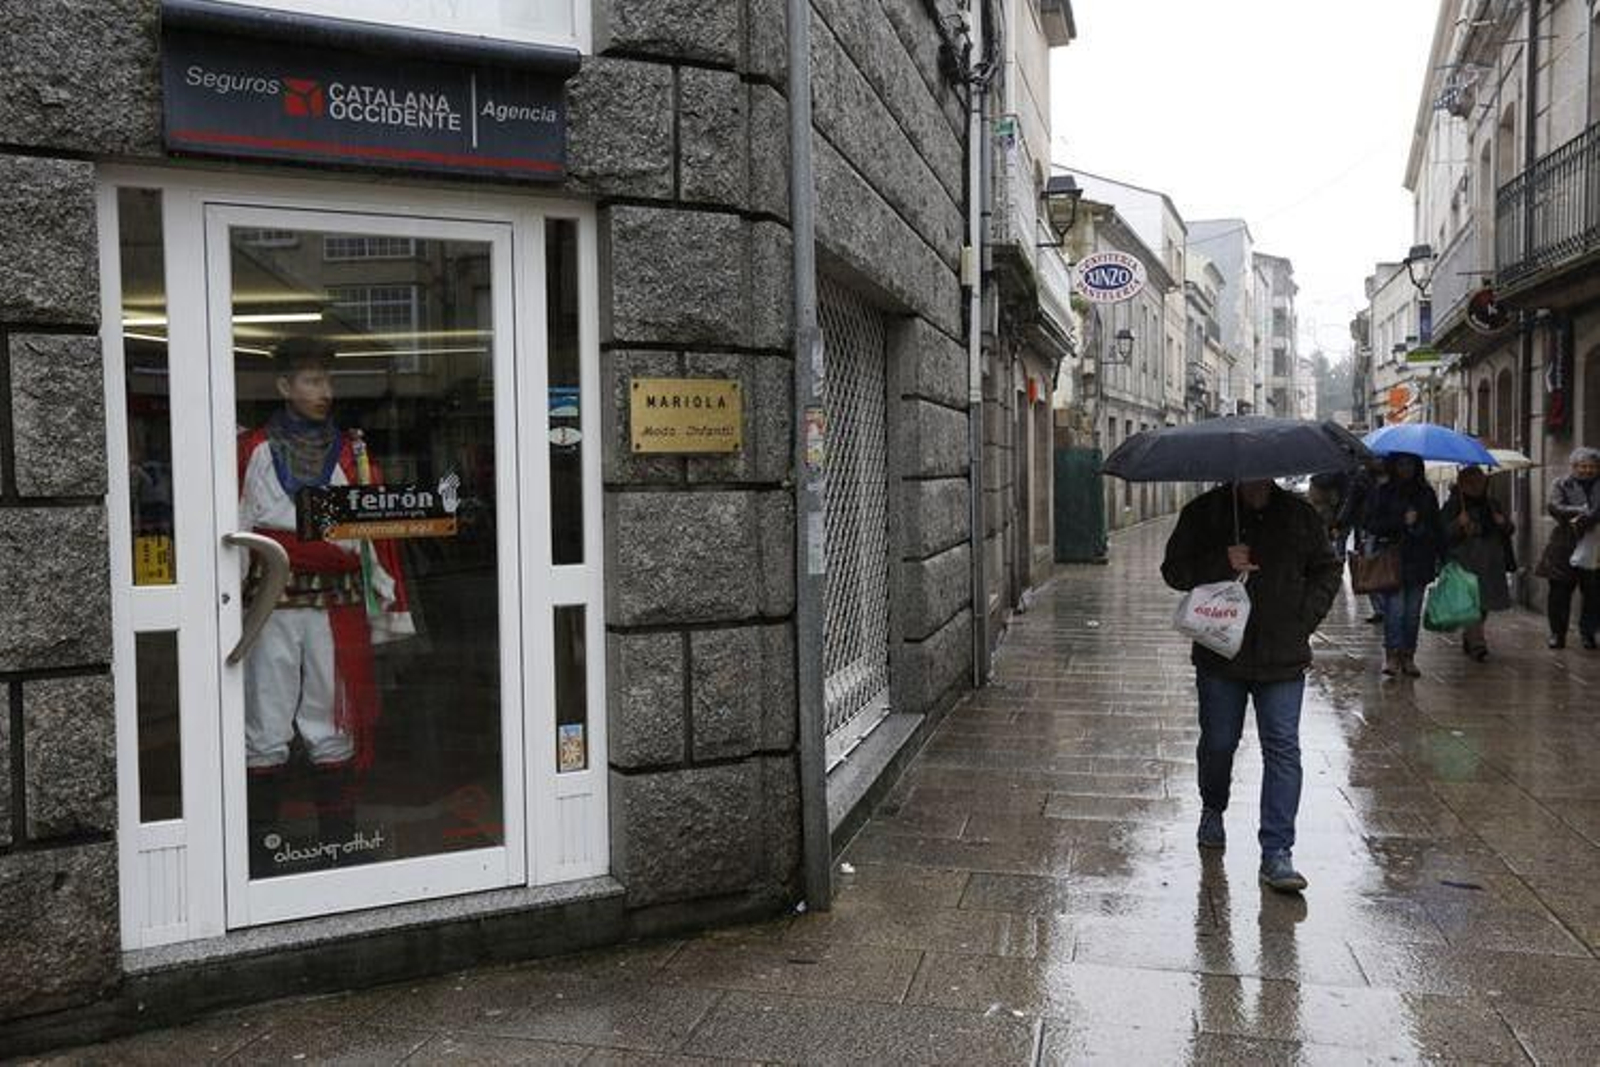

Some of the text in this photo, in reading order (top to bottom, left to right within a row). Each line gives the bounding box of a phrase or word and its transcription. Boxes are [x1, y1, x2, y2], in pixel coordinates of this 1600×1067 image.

[186, 65, 281, 95] Seguros
[328, 82, 451, 113] CATALANA
[328, 101, 461, 131] OCCIDENTE
[479, 100, 557, 124] Agencia
[646, 395, 726, 409] MARIOLA
[347, 485, 434, 511] feirón
